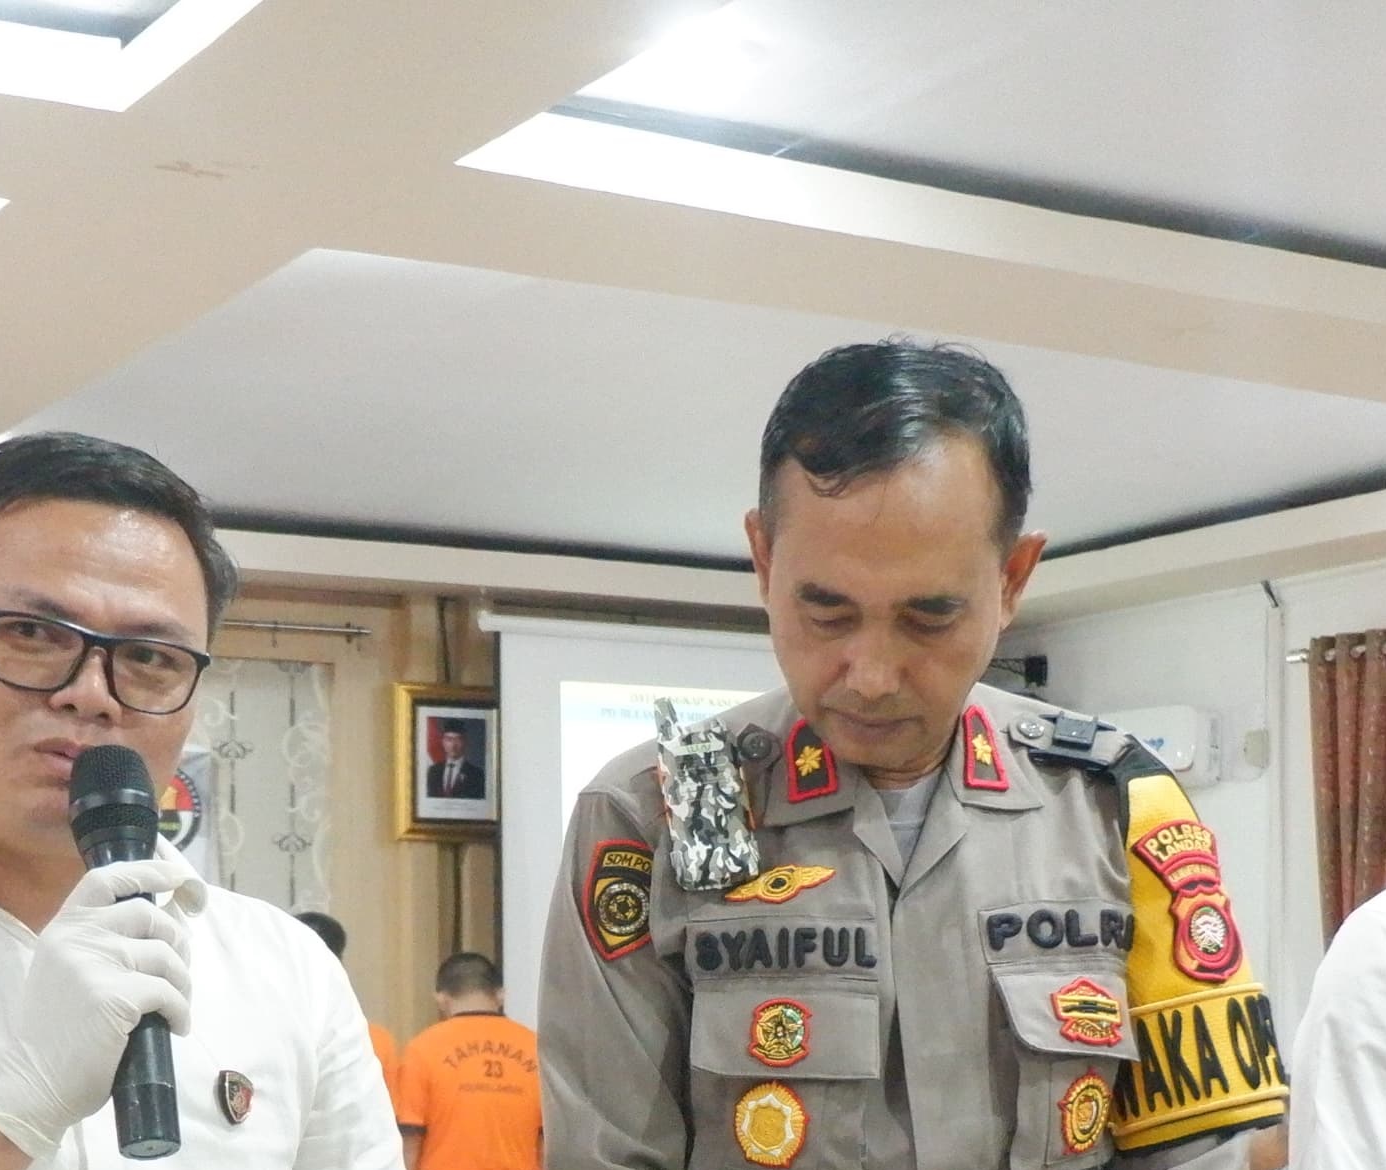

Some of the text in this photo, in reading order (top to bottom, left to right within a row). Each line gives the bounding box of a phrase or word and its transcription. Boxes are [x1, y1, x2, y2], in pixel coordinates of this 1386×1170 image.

[605, 853, 652, 873] SDM PO
[986, 908, 1135, 952] POLRI
[695, 926, 877, 971] SYAIFUL
[443, 1040, 538, 1073] TAHANAN
[484, 1060, 503, 1078] 23
